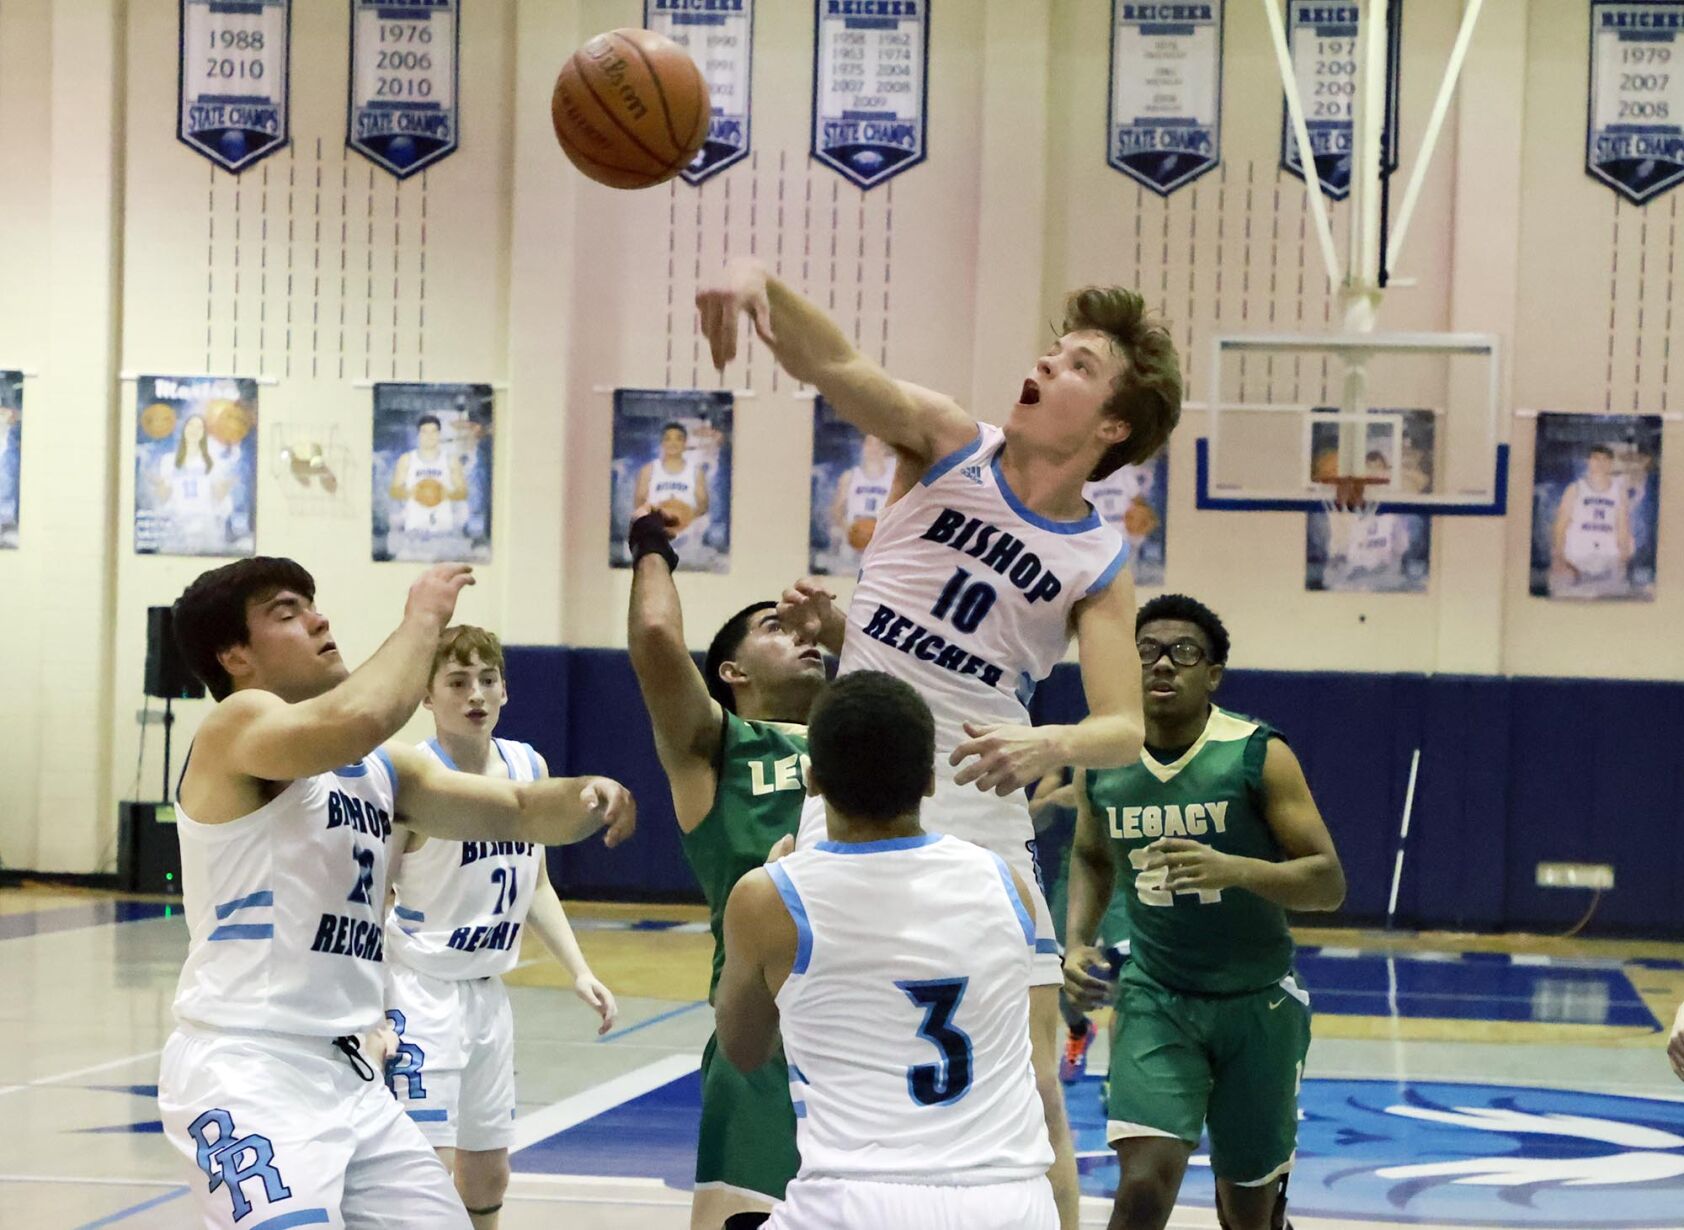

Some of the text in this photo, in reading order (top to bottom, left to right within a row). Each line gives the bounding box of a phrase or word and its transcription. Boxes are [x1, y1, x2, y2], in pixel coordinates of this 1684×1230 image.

[828, 0, 917, 15] REICHER
[1122, 5, 1212, 20] REICHER
[1298, 7, 1359, 22] REICH
[1601, 12, 1684, 27] REICHE
[208, 29, 264, 50] 1988
[379, 25, 433, 45] 1976
[1317, 41, 1356, 55] 197
[1621, 47, 1672, 65] 1979
[206, 58, 264, 79] 2010
[376, 50, 432, 70] 2006
[1315, 61, 1357, 75] 200
[376, 77, 432, 97] 2010
[1314, 81, 1356, 96] 200
[1619, 73, 1670, 91] 2007
[1312, 101, 1353, 116] 201
[1618, 100, 1670, 118] 2008
[188, 106, 279, 132] STATE CHAMPS
[357, 112, 450, 137] STATE CHAMPS
[823, 122, 916, 149] STATE CHAMPS
[1118, 129, 1212, 155] STATE CHAMPS
[1636, 135, 1684, 160] CHAMP
[920, 507, 1062, 604] BISHOP
[930, 566, 998, 635] 10
[862, 604, 1005, 687] REICHER
[1105, 800, 1229, 839] LEGACY
[491, 866, 518, 916] 21
[310, 913, 384, 962] REICHE
[894, 977, 975, 1107] 3
